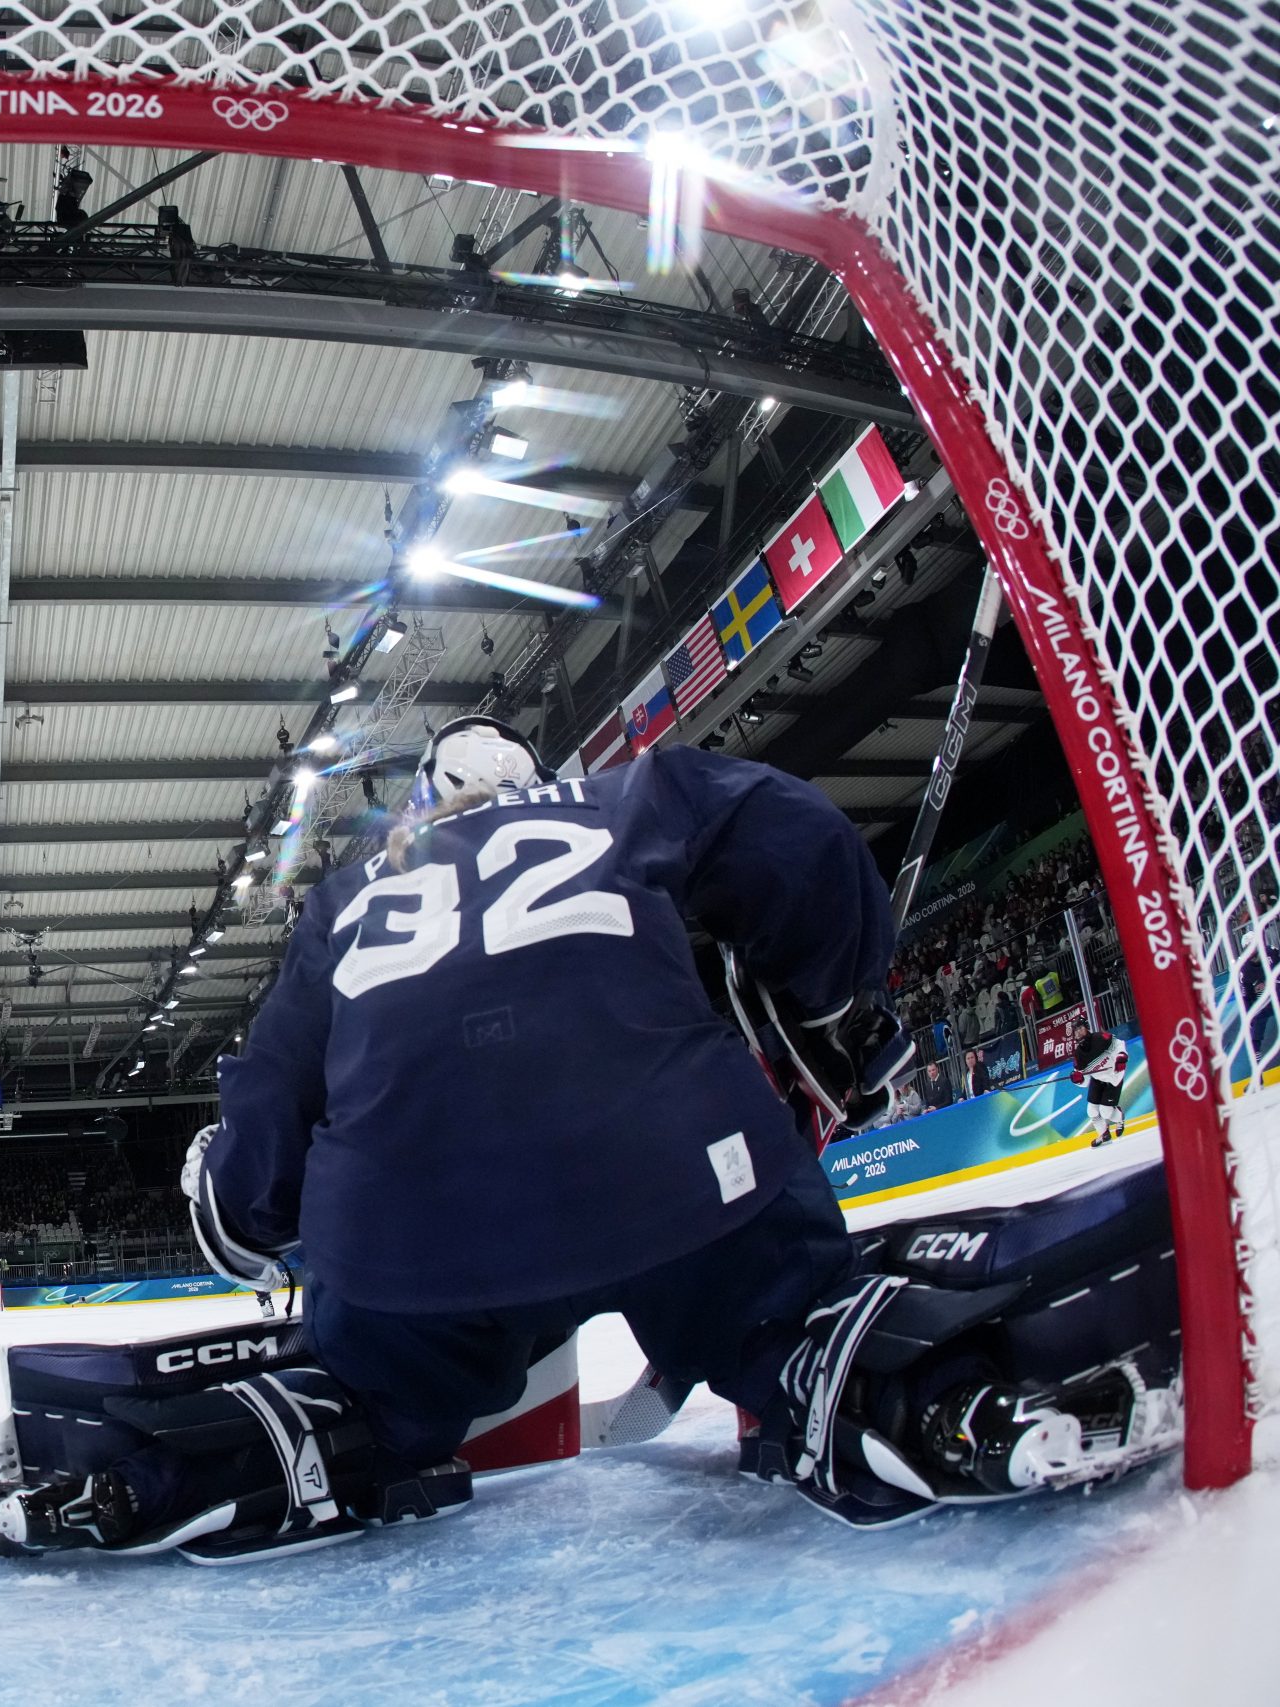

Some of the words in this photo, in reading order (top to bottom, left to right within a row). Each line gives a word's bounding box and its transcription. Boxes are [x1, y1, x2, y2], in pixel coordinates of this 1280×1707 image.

[86, 92, 164, 118] 2026
[929, 677, 978, 811] CCM
[1028, 585, 1100, 722] MILANO
[1088, 726, 1150, 888] CORTINA
[1138, 890, 1177, 972] 2026
[364, 777, 586, 882] PERT
[332, 820, 634, 1000] 32
[922, 893, 958, 918] CORTINA
[958, 881, 976, 898] 2026
[831, 1151, 872, 1172] MILANO
[873, 1138, 920, 1161] CORTINA
[864, 1163, 886, 1178] 2026
[906, 1232, 988, 1262] CCM
[156, 1336, 278, 1374] CCM
